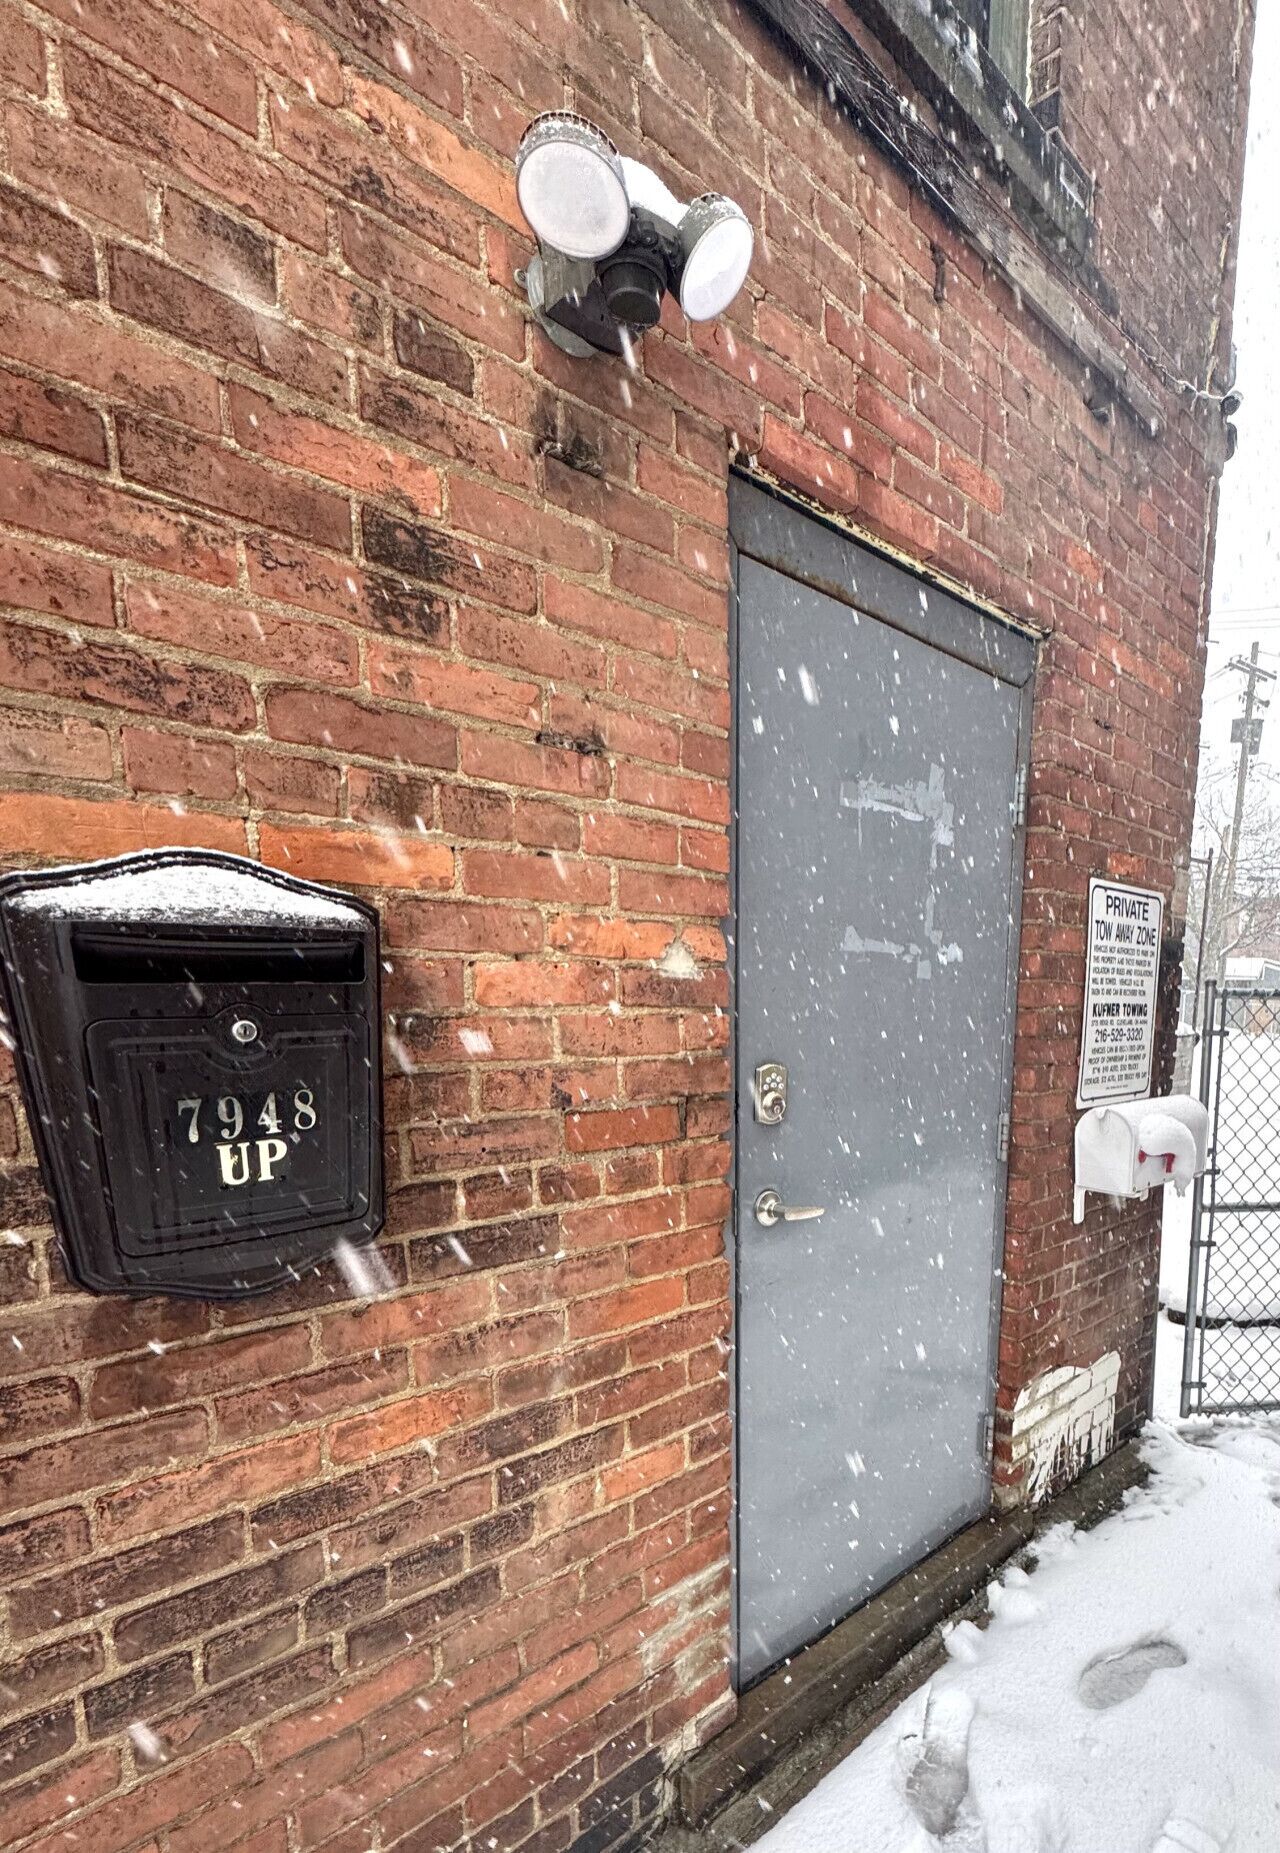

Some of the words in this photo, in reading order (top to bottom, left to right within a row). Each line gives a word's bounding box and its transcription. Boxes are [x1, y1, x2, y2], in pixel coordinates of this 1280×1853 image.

[1106, 895, 1149, 921] PRIVATE
[1095, 920, 1113, 941] TOW
[1115, 923, 1134, 943] AWAY
[1137, 927, 1156, 946] ZONE
[1093, 1003, 1120, 1017] KUFNER
[1123, 1003, 1147, 1017] TOWING
[1095, 1028, 1143, 1043] 216-529-3320
[177, 1089, 316, 1143] 7948
[216, 1138, 288, 1185] UP
